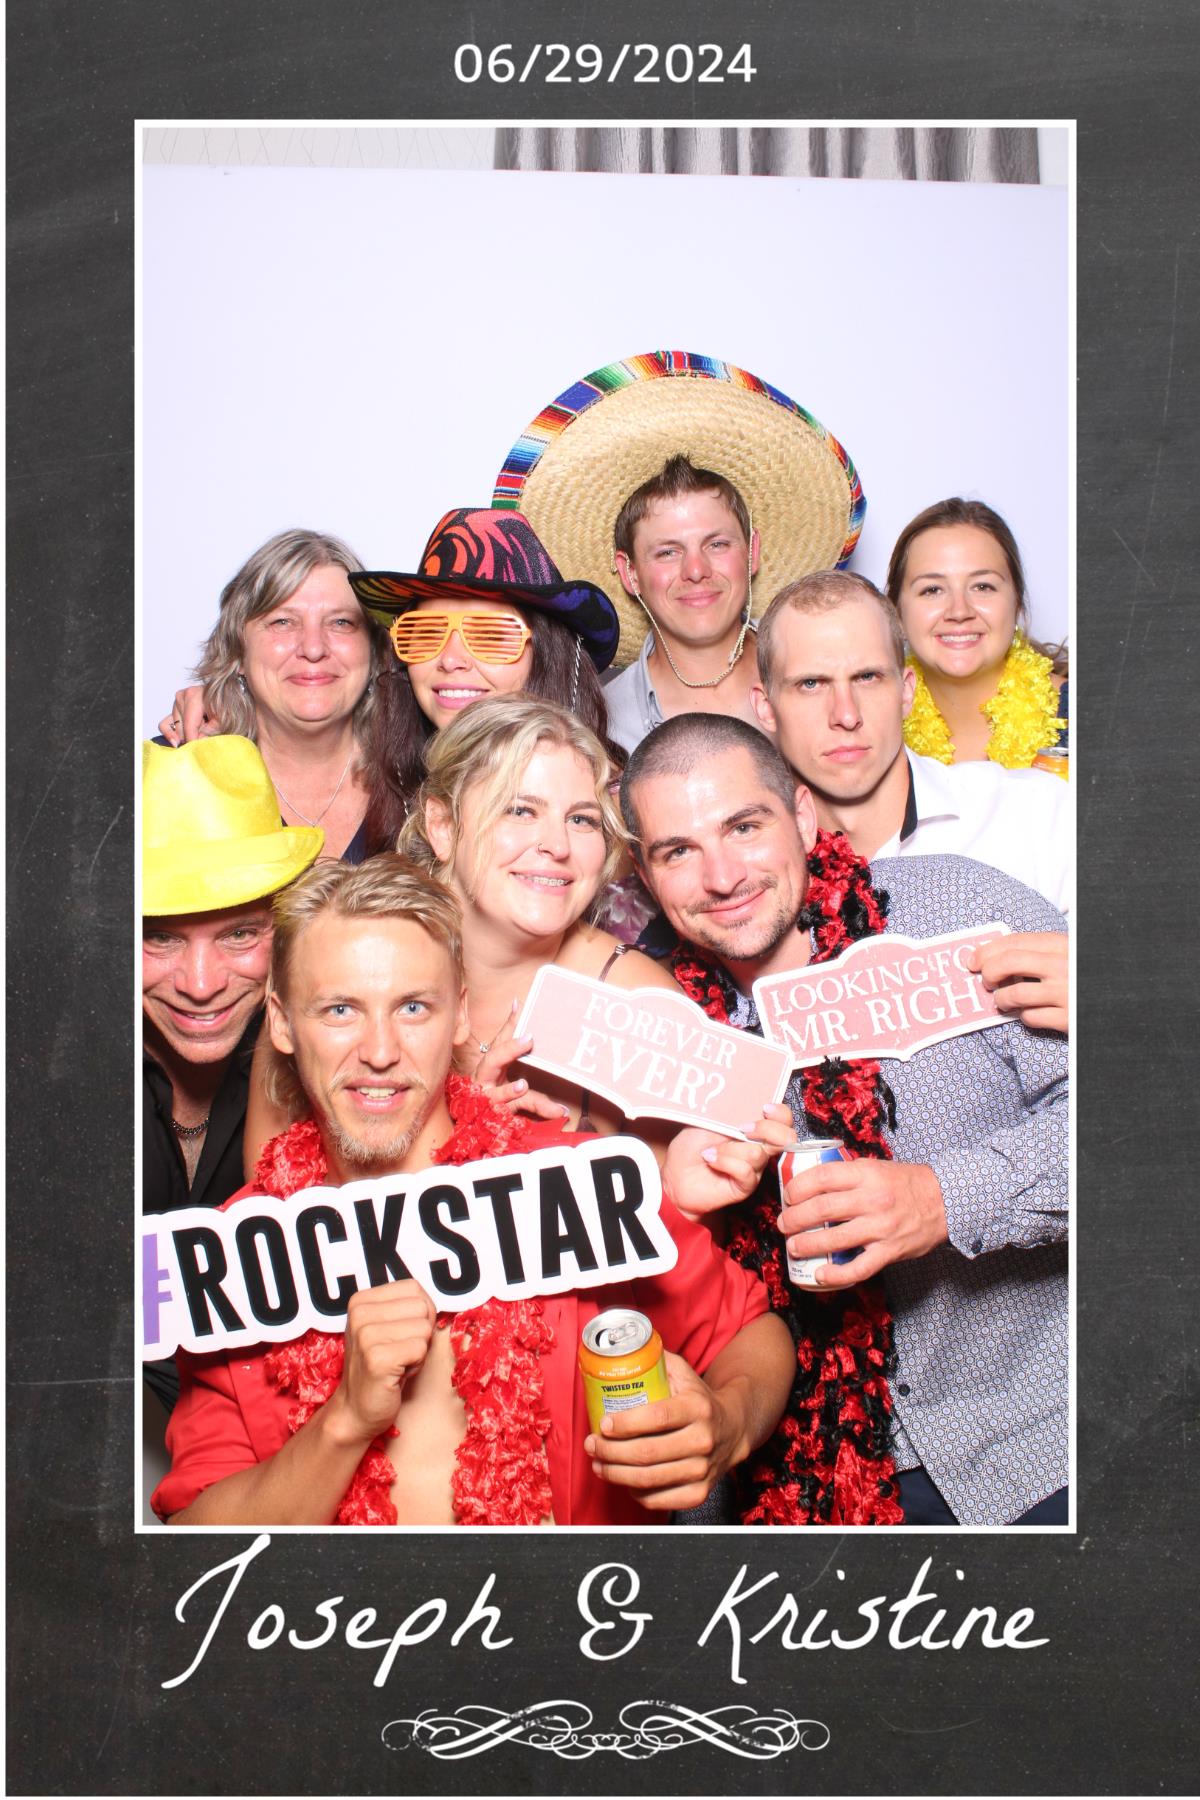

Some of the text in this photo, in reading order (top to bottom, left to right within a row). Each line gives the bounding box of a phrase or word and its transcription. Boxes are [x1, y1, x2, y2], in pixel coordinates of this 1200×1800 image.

[769, 940, 993, 1017] LOOKING FO
[778, 973, 985, 1052] MR. RIGH
[567, 1025, 727, 1114] EVER?
[583, 992, 738, 1070] FOREVER
[601, 1381, 644, 1393] TWISTED TEA
